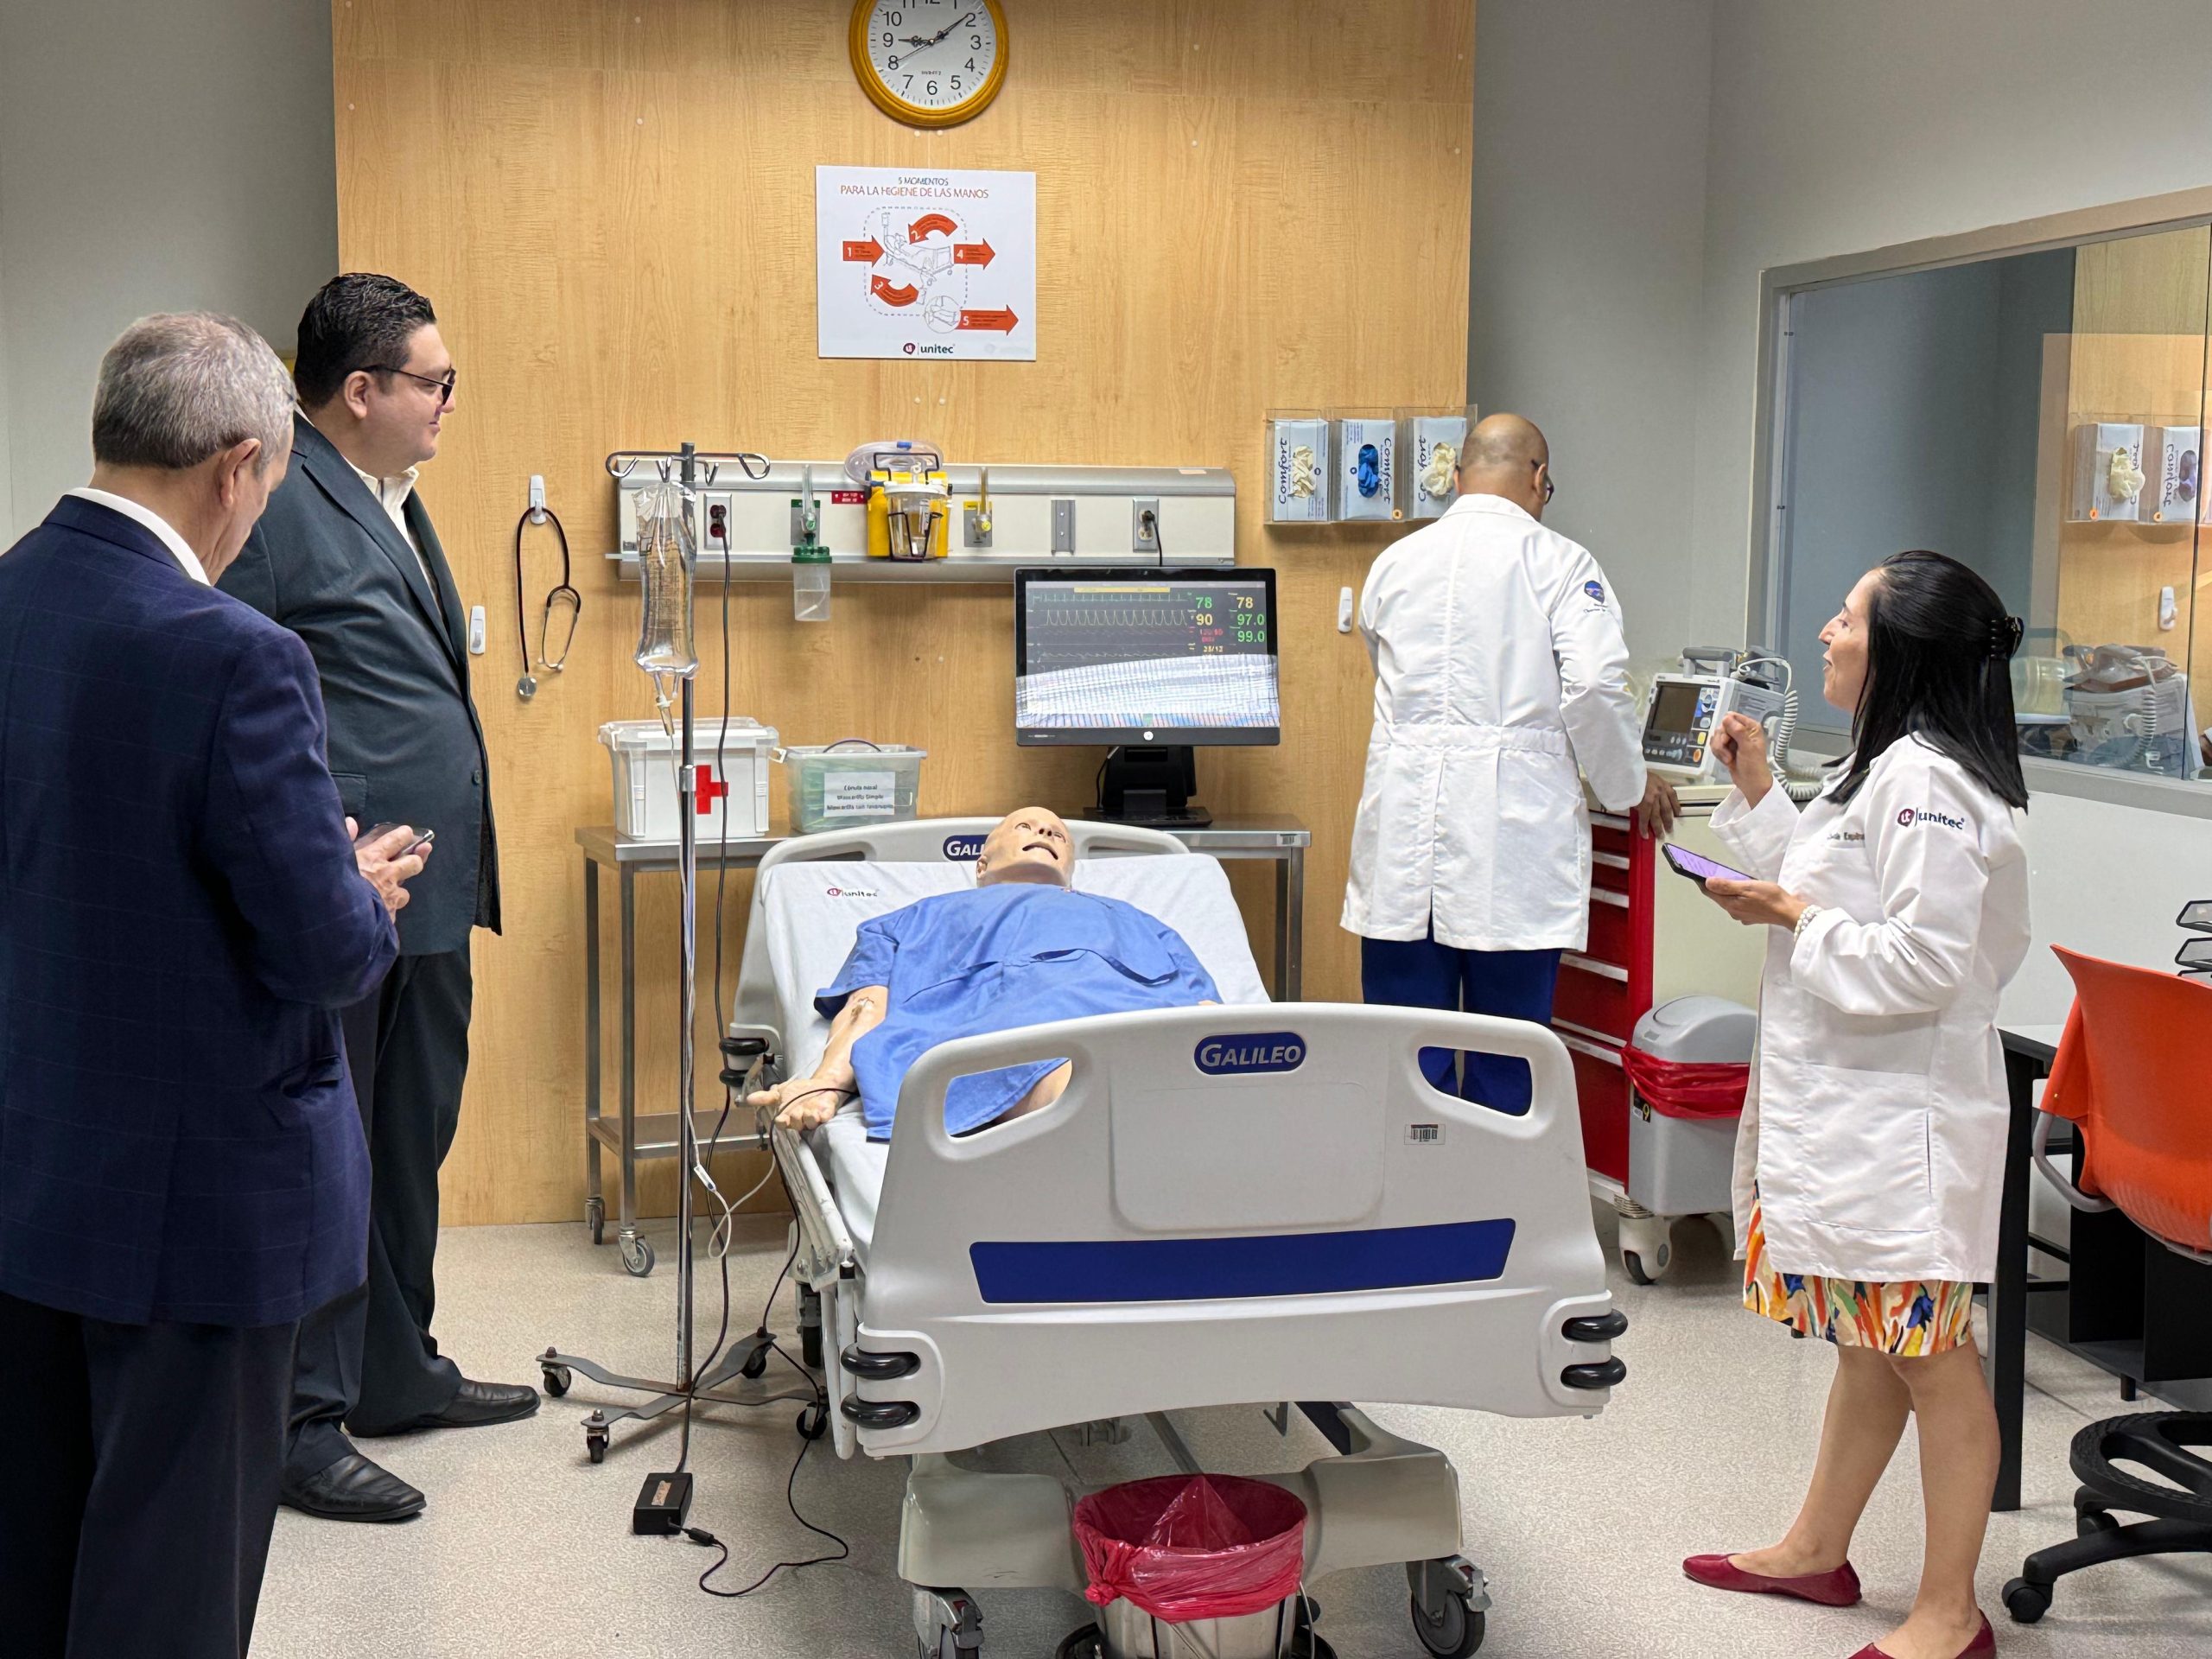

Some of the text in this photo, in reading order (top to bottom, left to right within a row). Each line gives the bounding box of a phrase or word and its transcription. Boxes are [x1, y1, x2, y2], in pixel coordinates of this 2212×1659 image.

[882, 11, 902, 27] 10
[964, 12, 976, 27] 2
[882, 32, 893, 48] 9
[970, 35, 982, 50] 3
[887, 55, 899, 70] 8
[963, 57, 976, 73] 4
[902, 74, 914, 89] 7
[926, 79, 938, 95] 6
[950, 75, 961, 90] 5
[904, 176, 949, 187] MOMENTOS
[840, 185, 989, 199] PARA LA HIGIENE DE LAS MANOS
[911, 230, 921, 241] 2
[847, 247, 852, 257] 1
[874, 281, 884, 290] 3
[963, 315, 969, 327] 5
[920, 344, 954, 354] unitec
[1279, 437, 1288, 505] Comfort
[1382, 437, 1392, 505] Comfort
[1418, 435, 1427, 502] Cofort
[1195, 596, 1212, 609] 78
[1236, 596, 1254, 609] 78
[1196, 613, 1213, 626] 90
[1236, 613, 1265, 626] 97.0
[1237, 630, 1265, 643] 99.0
[1918, 811, 1964, 830] unitec
[946, 840, 986, 856] GALI
[1200, 1044, 1301, 1067] GALILEO
